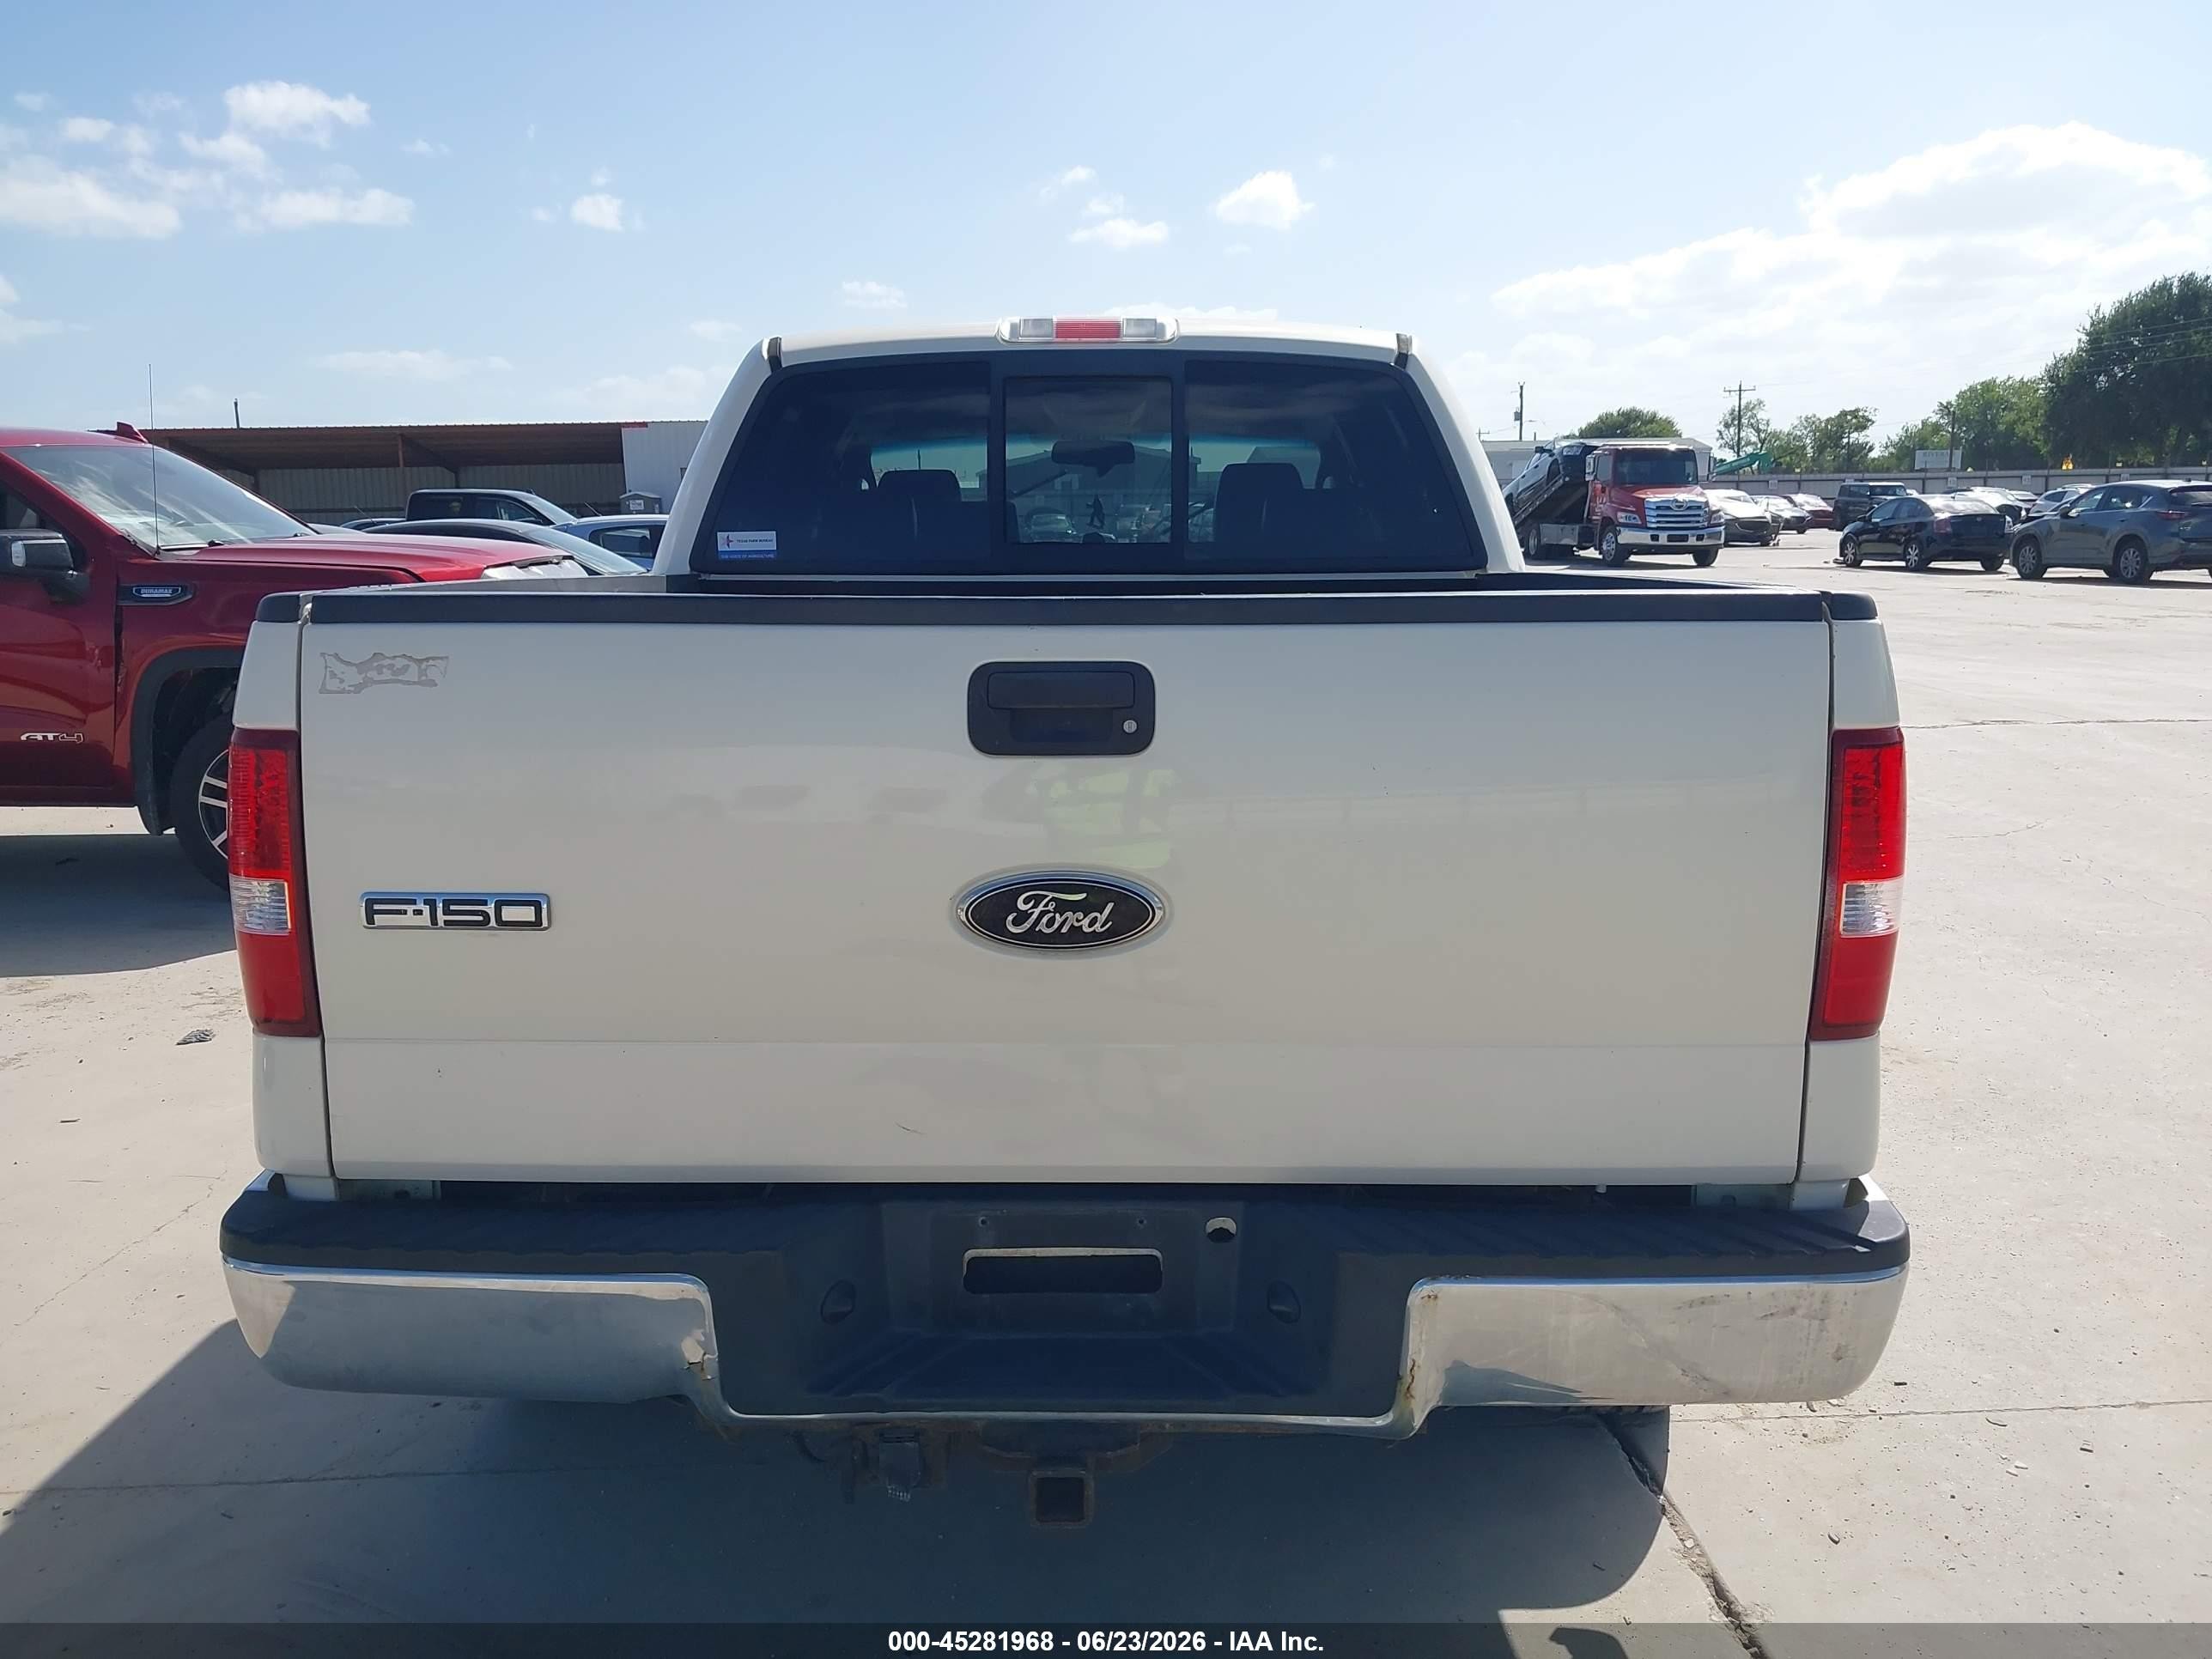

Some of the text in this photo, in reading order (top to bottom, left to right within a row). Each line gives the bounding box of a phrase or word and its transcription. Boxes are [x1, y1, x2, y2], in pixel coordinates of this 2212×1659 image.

[21, 732, 83, 744] AT4
[364, 897, 544, 927] F-150
[1006, 890, 1115, 933] Ford
